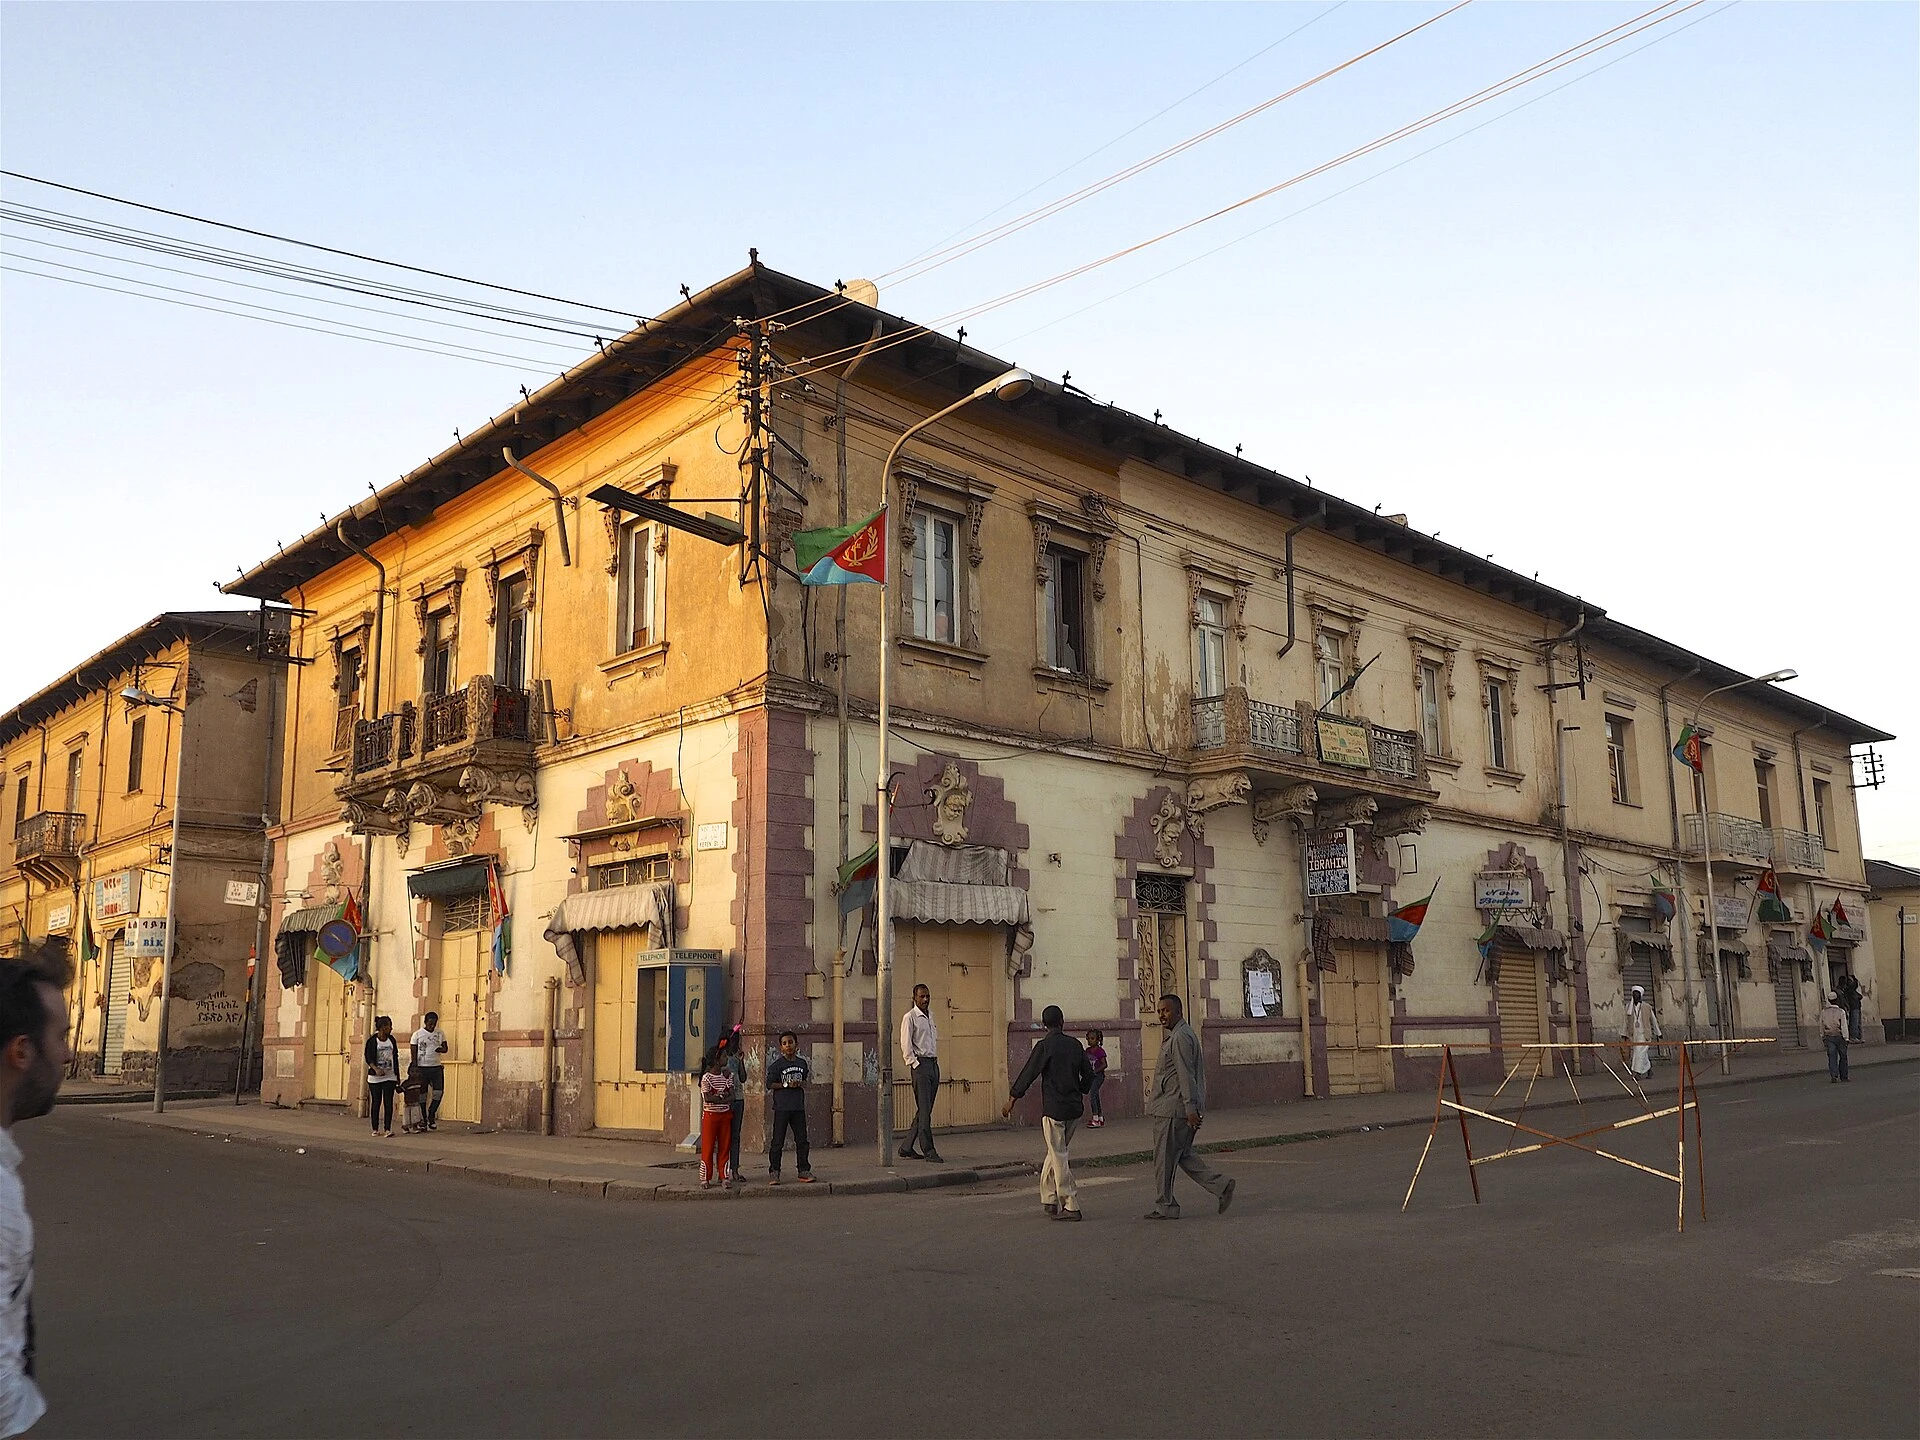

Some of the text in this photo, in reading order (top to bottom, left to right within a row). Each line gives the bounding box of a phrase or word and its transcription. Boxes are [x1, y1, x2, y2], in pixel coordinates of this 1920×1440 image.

[1309, 857, 1348, 870] IBRAHIM
[640, 953, 666, 961] TELEPHONE
[675, 952, 717, 960] TELEPHONE
